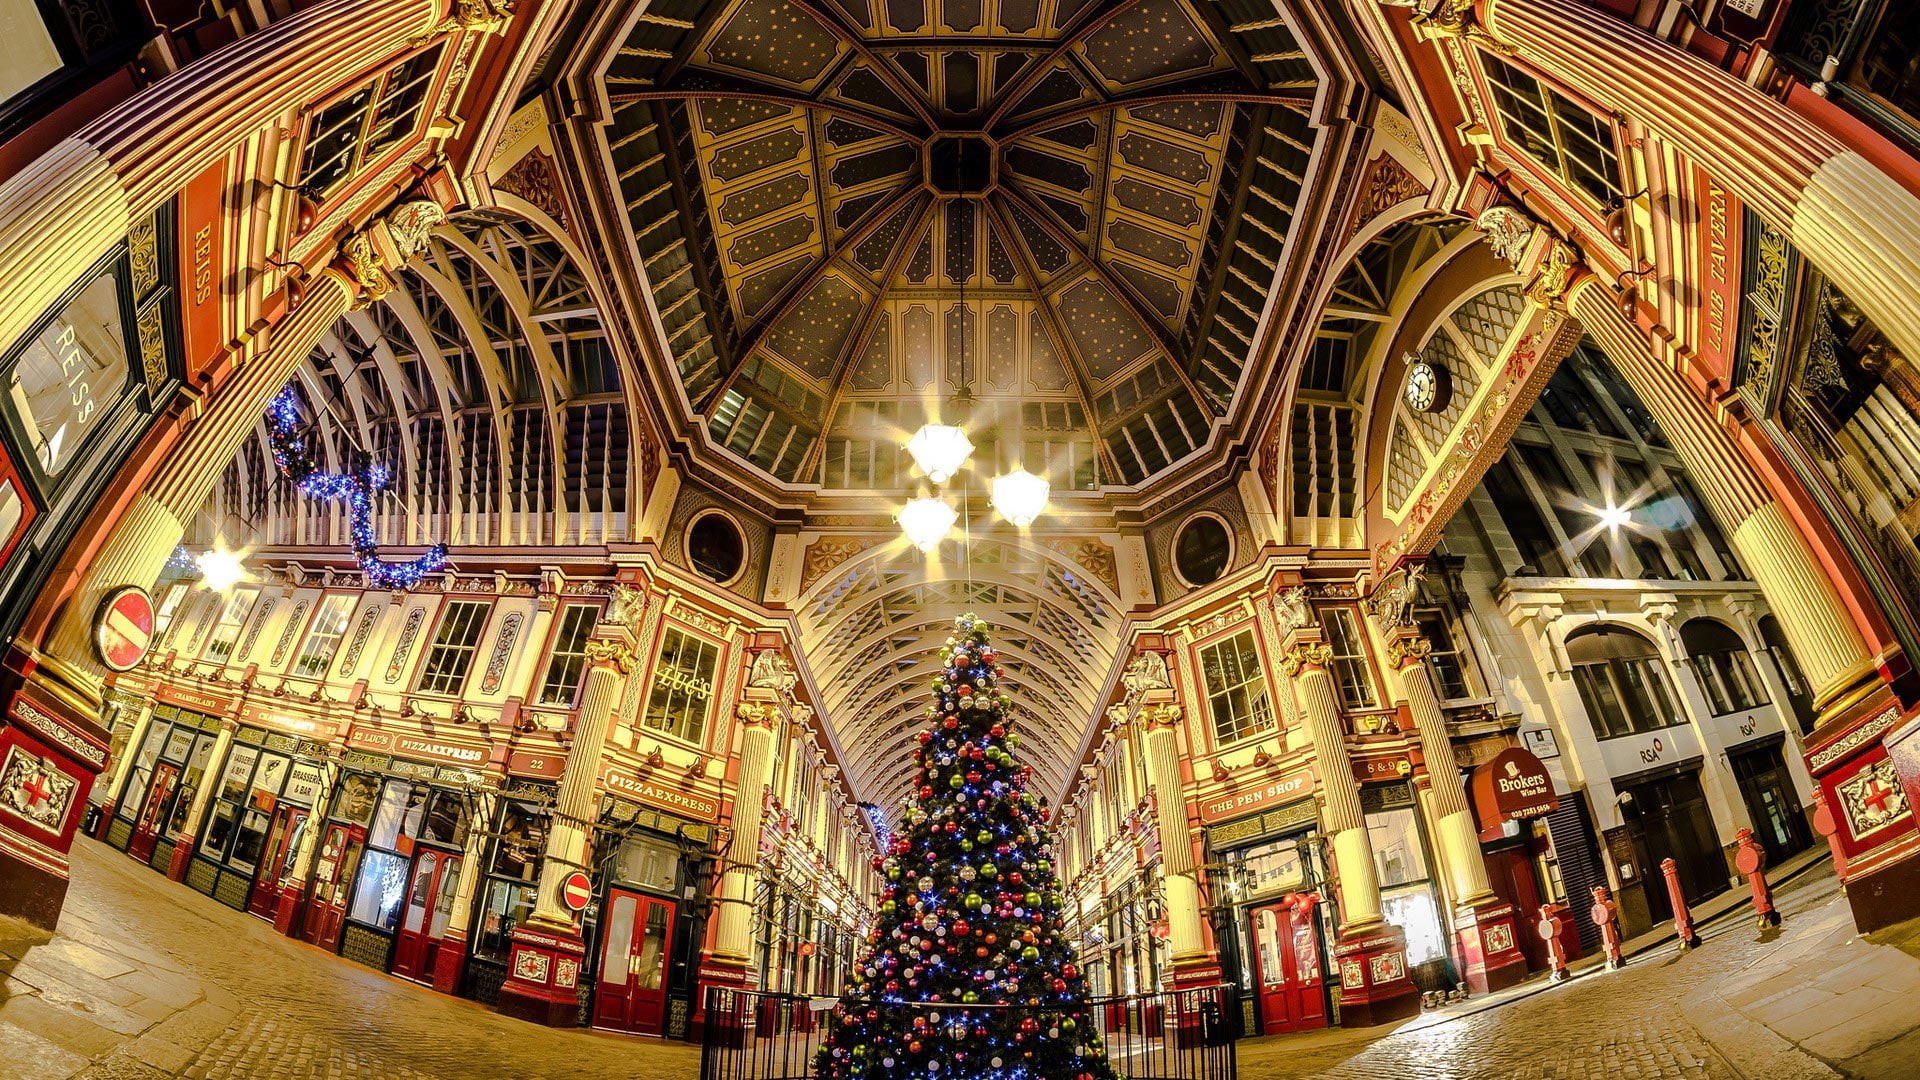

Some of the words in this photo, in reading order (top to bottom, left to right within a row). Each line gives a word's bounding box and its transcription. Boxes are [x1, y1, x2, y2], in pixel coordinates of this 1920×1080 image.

[1708, 179, 1728, 285] TAVERN
[195, 222, 211, 306] REISS
[1708, 289, 1726, 353] LAMB
[56, 324, 94, 424] REISS
[659, 667, 712, 700] LUC'S
[353, 731, 363, 740] 22
[364, 732, 389, 745] LUC'S
[1740, 724, 1755, 736] RSA
[401, 739, 482, 761] PIZZAEXPRESS
[1640, 748, 1661, 764] RSA
[530, 759, 544, 770] 22
[1367, 763, 1375, 773] 8
[1377, 762, 1386, 772] &
[1388, 761, 1396, 771] 9
[292, 769, 321, 785] BRASSERIE
[1498, 774, 1545, 793] Brokers
[299, 788, 312, 796] BAR
[610, 774, 713, 814] PIZZAEXPRESS
[1209, 799, 1234, 814] THE
[1237, 790, 1263, 807] PEN
[1267, 778, 1303, 797] SHOP
[1520, 788, 1536, 798] Wine
[1537, 786, 1547, 794] Bar
